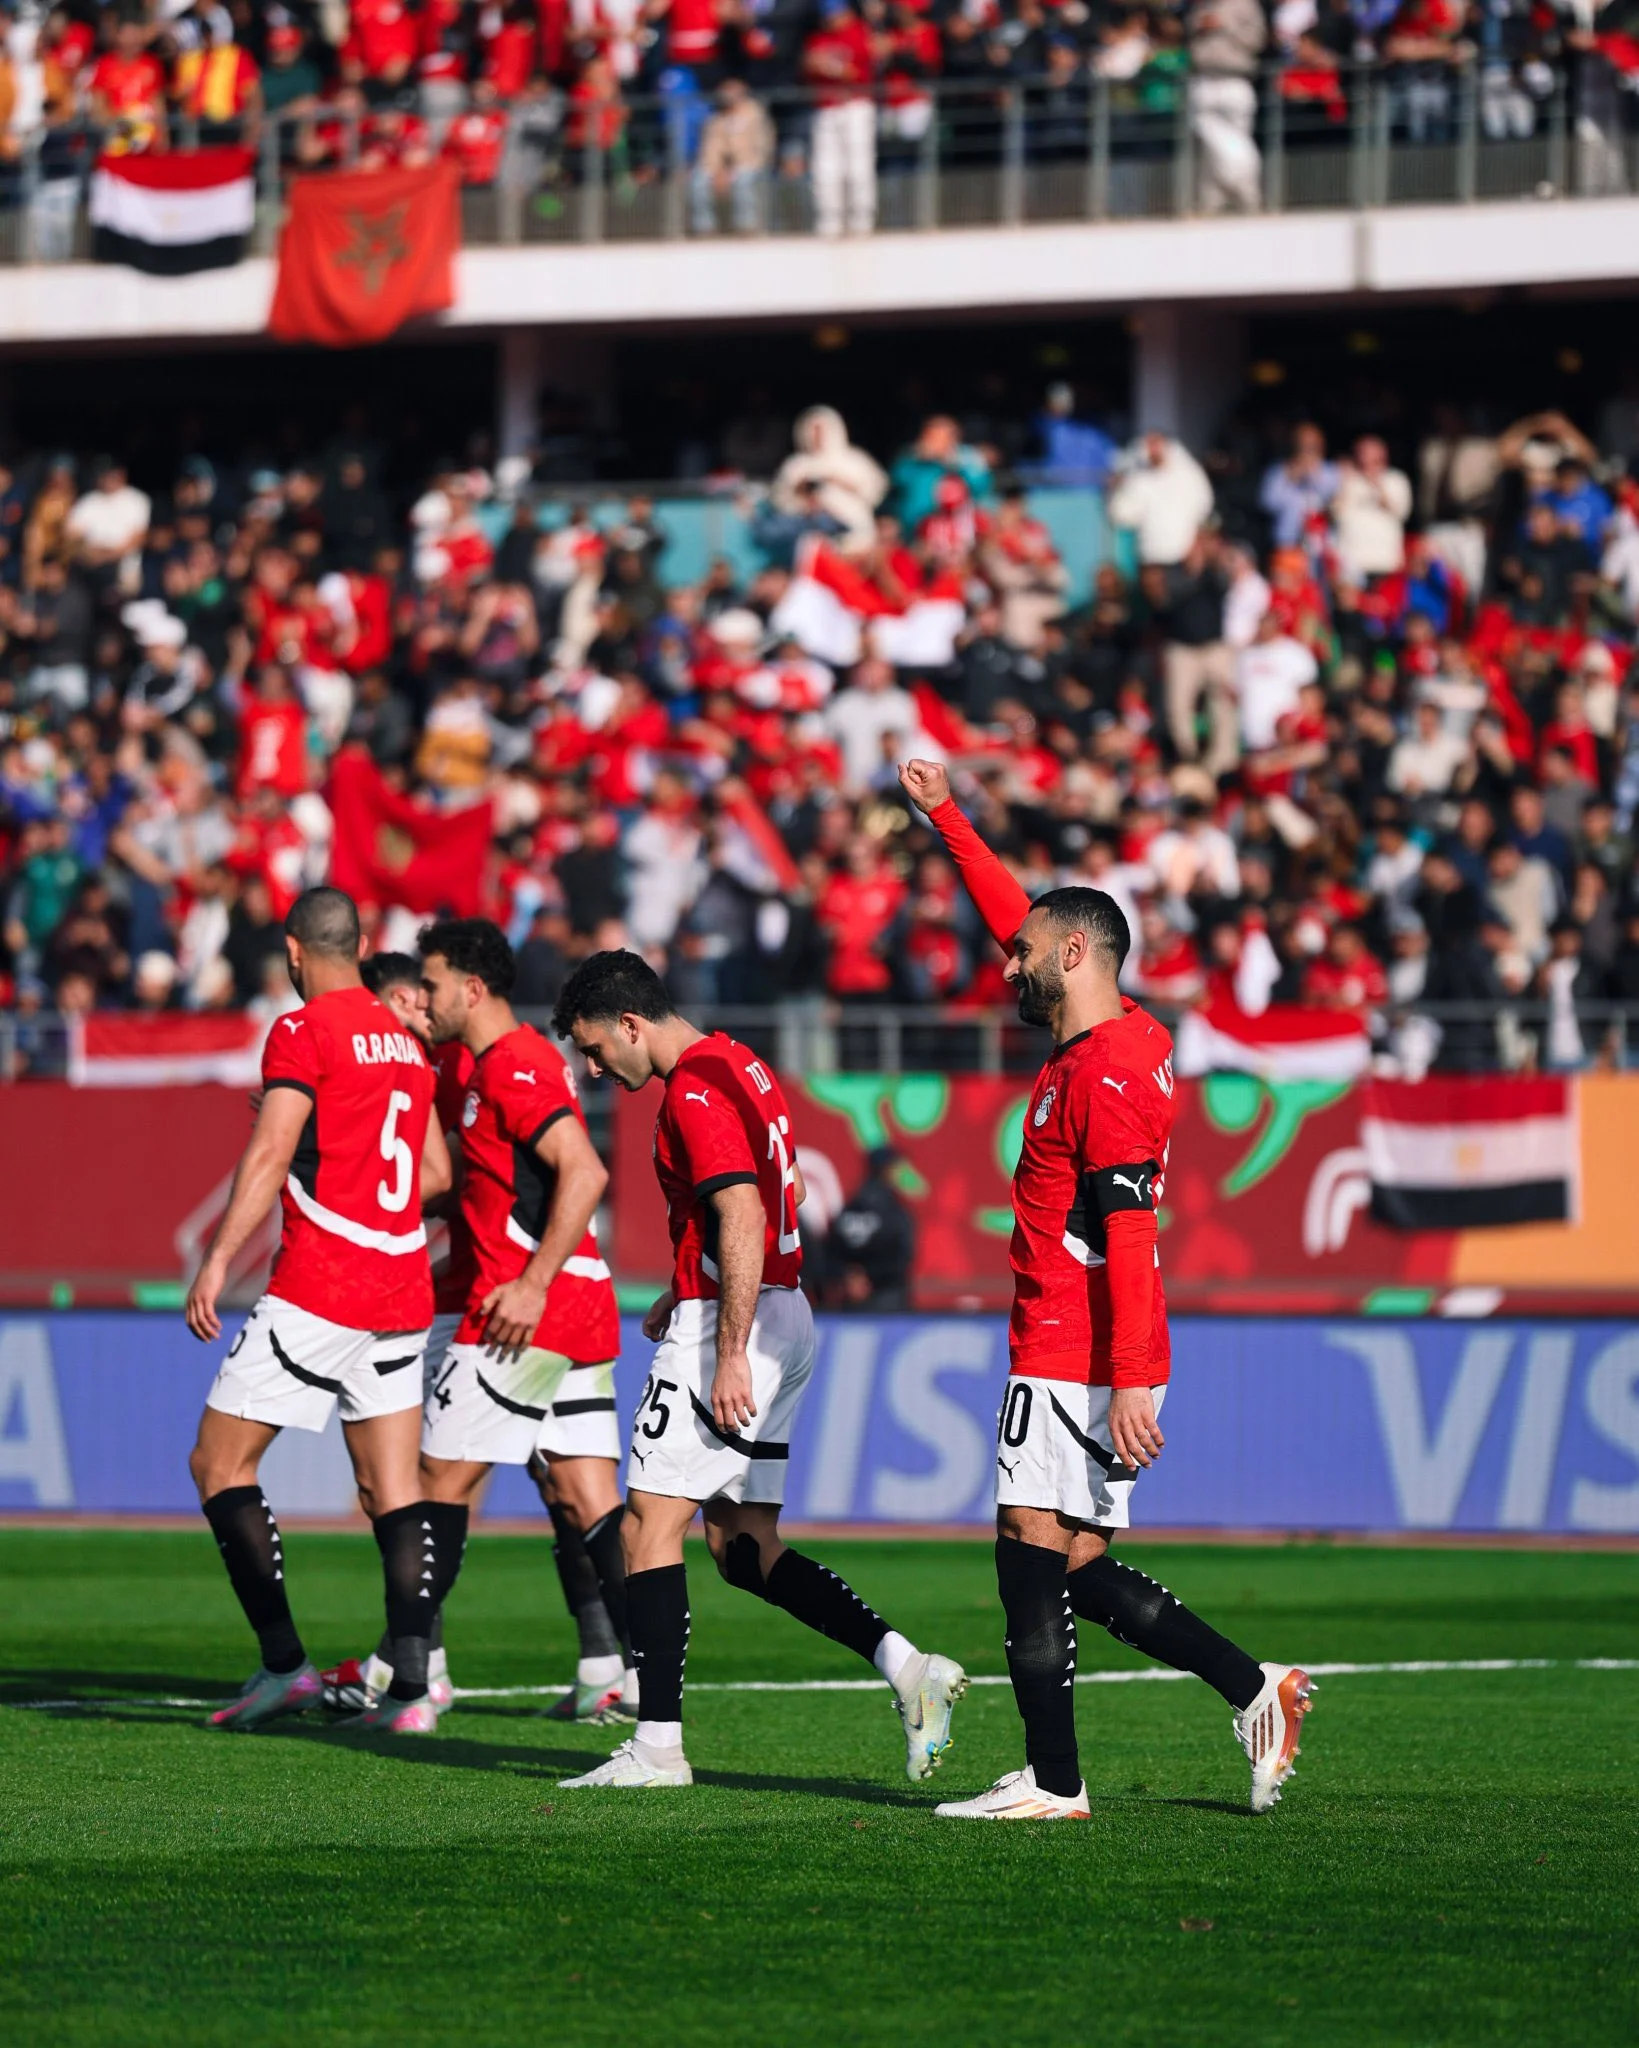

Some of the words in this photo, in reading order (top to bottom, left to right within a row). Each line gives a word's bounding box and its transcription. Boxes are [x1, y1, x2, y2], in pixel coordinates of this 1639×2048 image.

[377, 1089, 414, 1213] 5
[633, 1373, 679, 1440] 25
[997, 1380, 1034, 1449] 10
